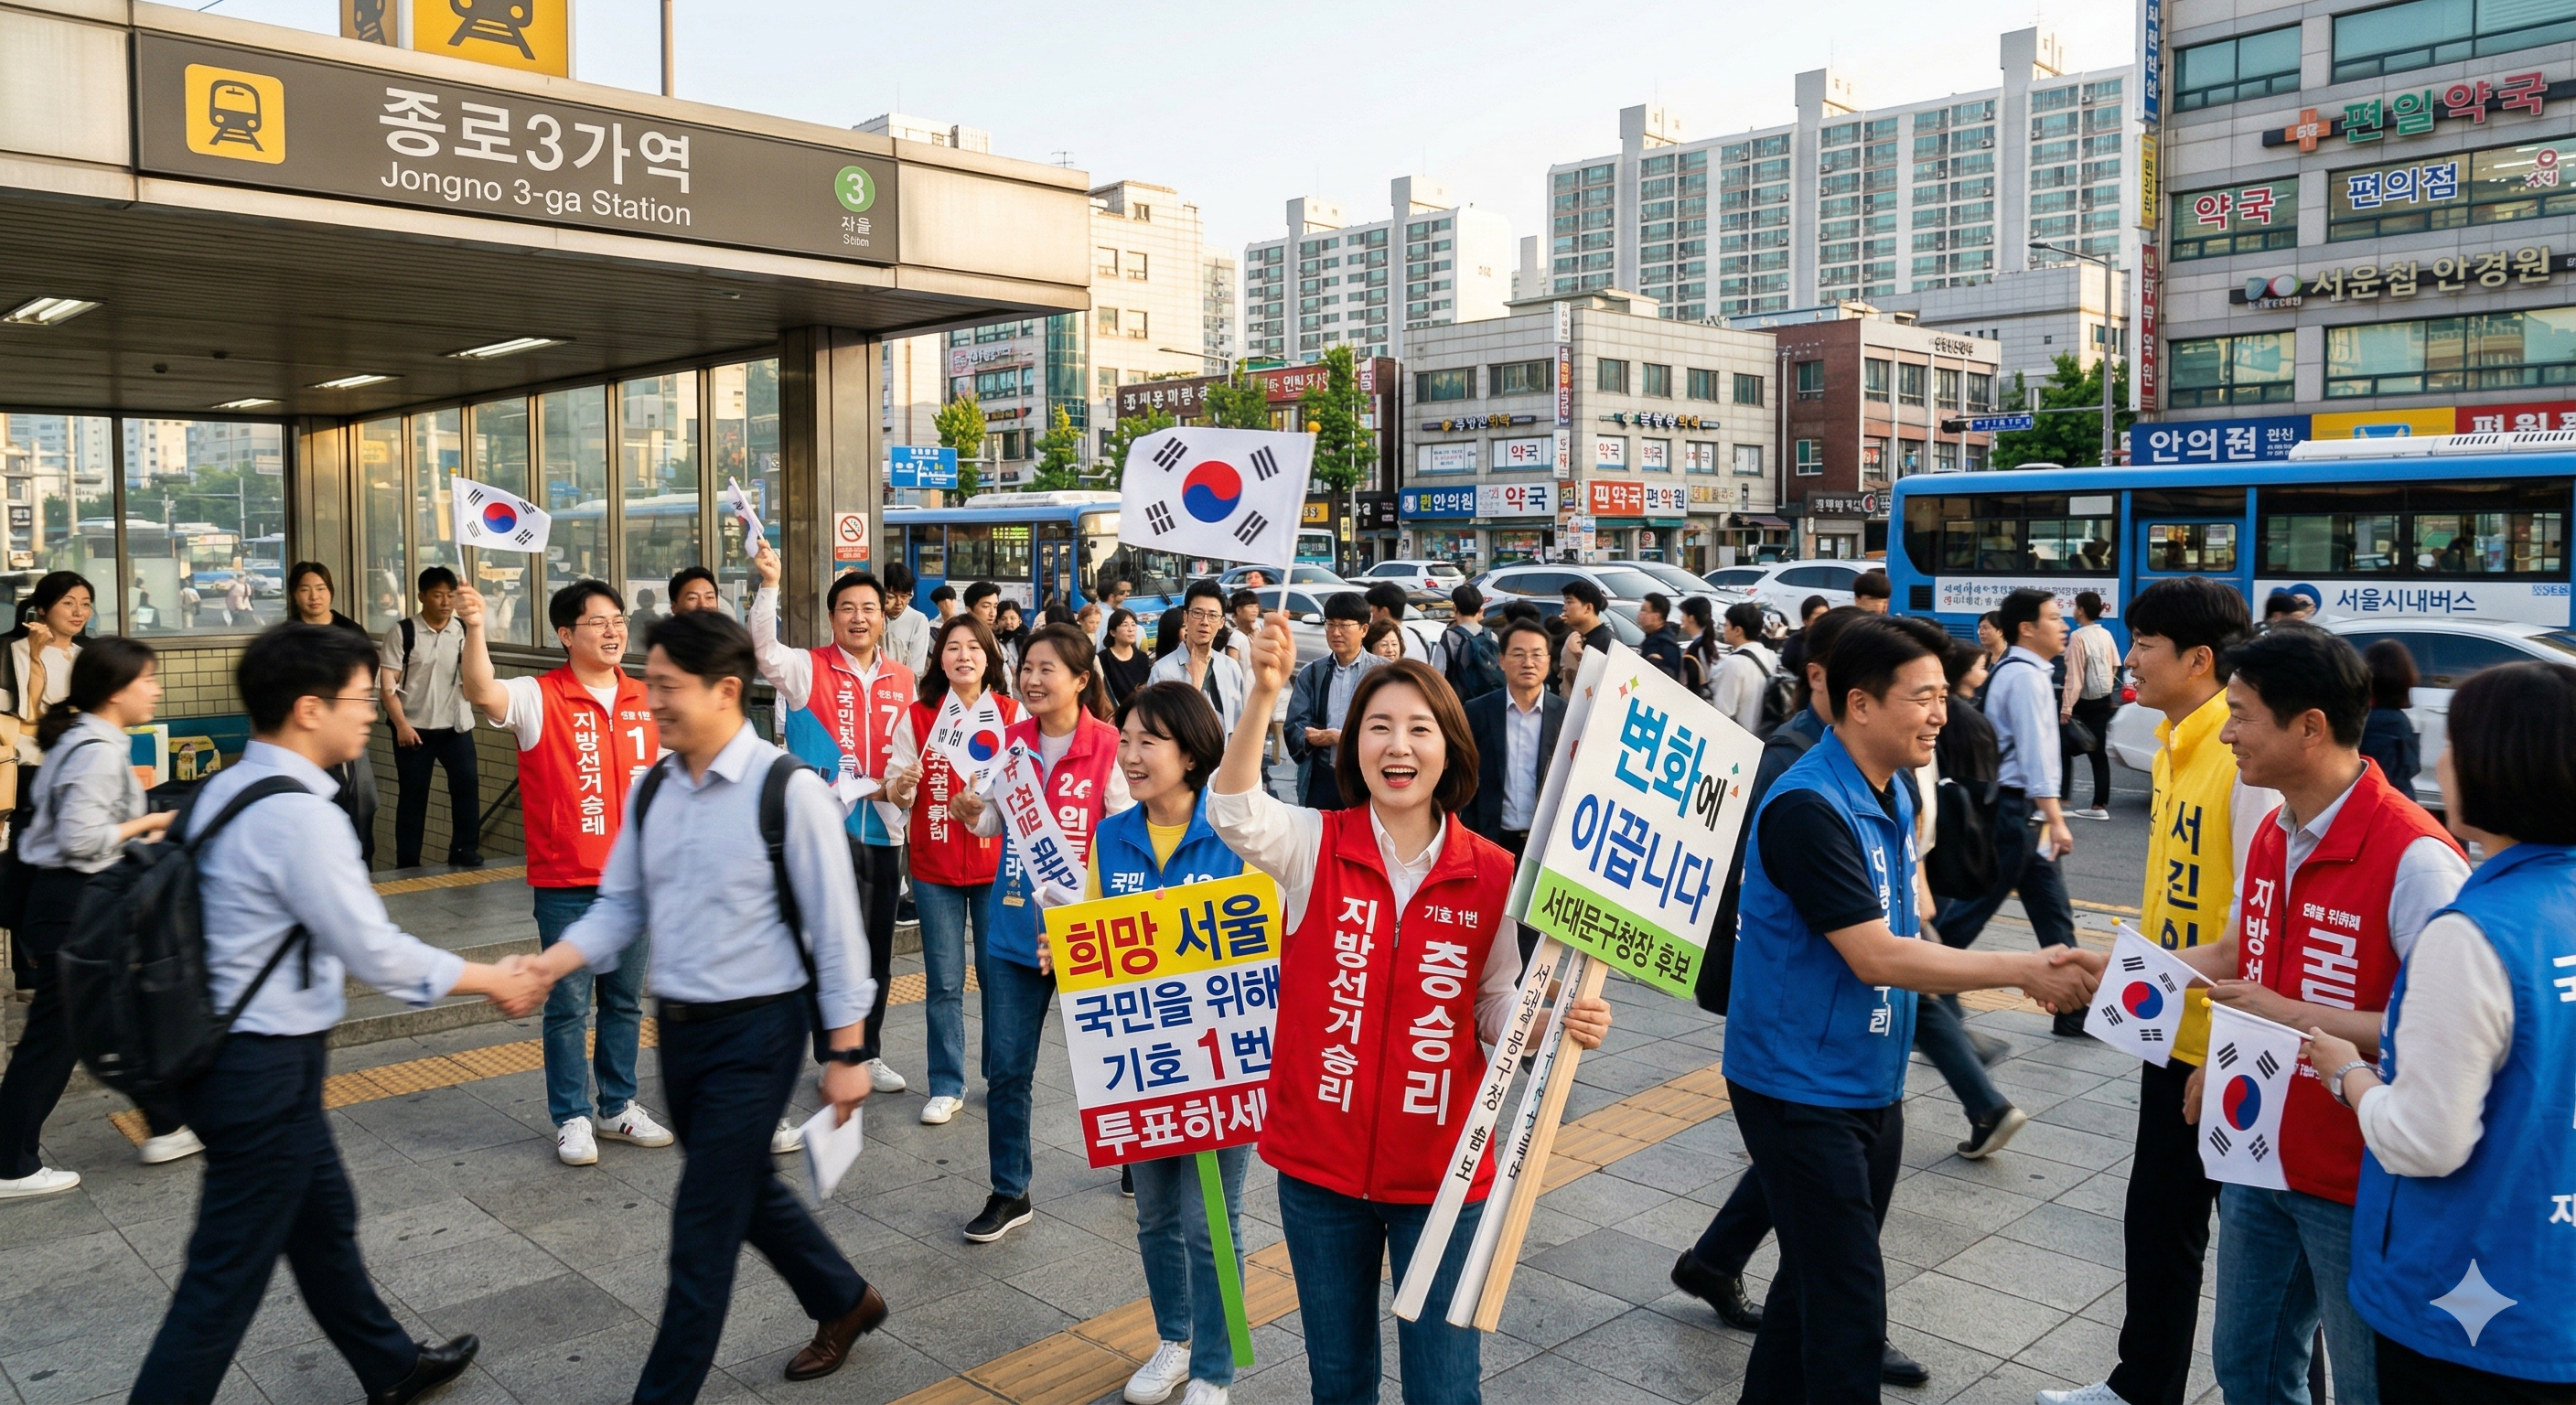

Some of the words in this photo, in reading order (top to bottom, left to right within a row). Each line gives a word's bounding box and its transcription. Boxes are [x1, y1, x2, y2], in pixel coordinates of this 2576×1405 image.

[2341, 71, 2549, 145] 편일약국
[379, 87, 690, 194] 종로3가역
[381, 161, 502, 202] Jongno
[513, 178, 582, 215] 3-ga
[592, 189, 692, 226] Station
[846, 173, 865, 205] 3
[2195, 187, 2277, 231] 약국
[2347, 161, 2460, 210] 편의점
[2431, 244, 2552, 293] 안경원
[1511, 445, 1539, 462] 약국
[1505, 487, 1548, 512] 약국
[2336, 587, 2477, 614] 서울시내버스
[627, 726, 646, 760] 1
[880, 704, 898, 736] 7
[1615, 696, 1728, 832] 변화에
[1111, 872, 1145, 893] 국민
[1065, 909, 1159, 980] 희망
[1175, 894, 1270, 961] 서울
[1423, 905, 1454, 926] 기호
[1458, 910, 1479, 929] 1번
[1541, 885, 1655, 970] 서대문구청장
[1653, 943, 1695, 985] 후보
[1074, 981, 1194, 1038] 국민을
[1206, 964, 1280, 1018] 위해
[1317, 896, 1379, 1113] 지방선거승리
[1102, 1042, 1189, 1093] 기호
